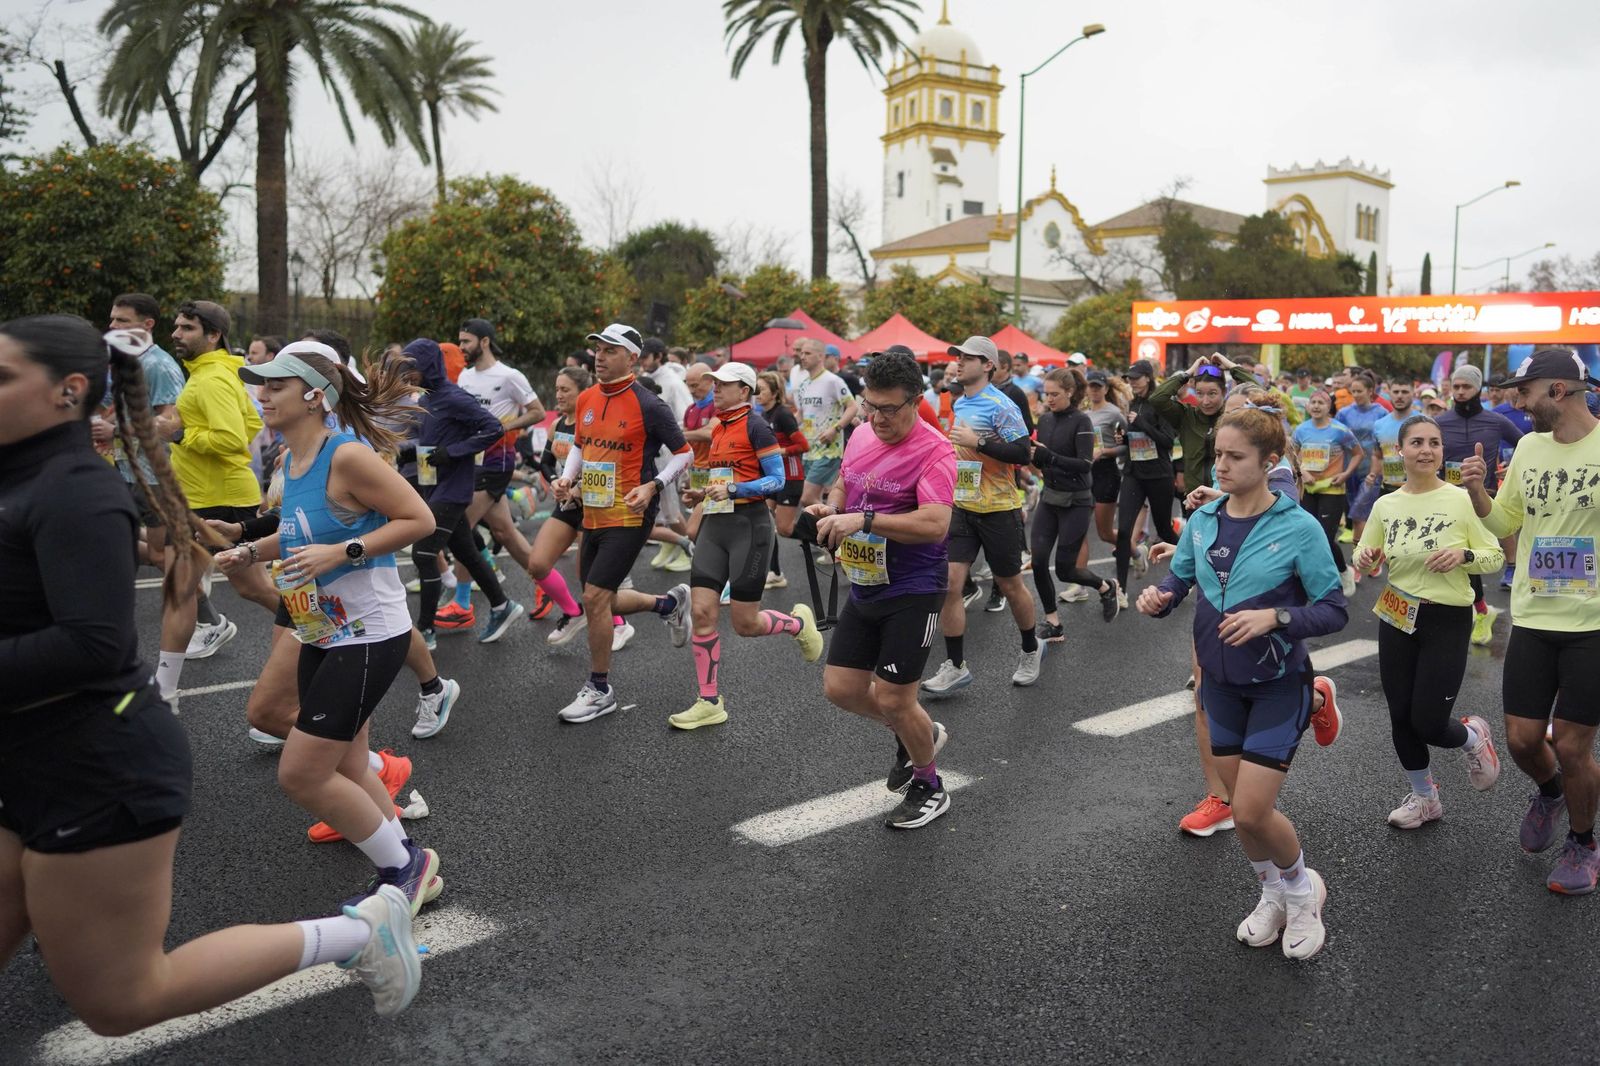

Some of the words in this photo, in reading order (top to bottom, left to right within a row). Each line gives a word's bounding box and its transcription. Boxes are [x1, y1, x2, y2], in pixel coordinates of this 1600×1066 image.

[594, 438, 633, 452] CAMAS
[957, 471, 974, 484] 186
[843, 540, 876, 563] 15948
[1534, 551, 1578, 569] 3617
[1383, 590, 1408, 616] 4903
